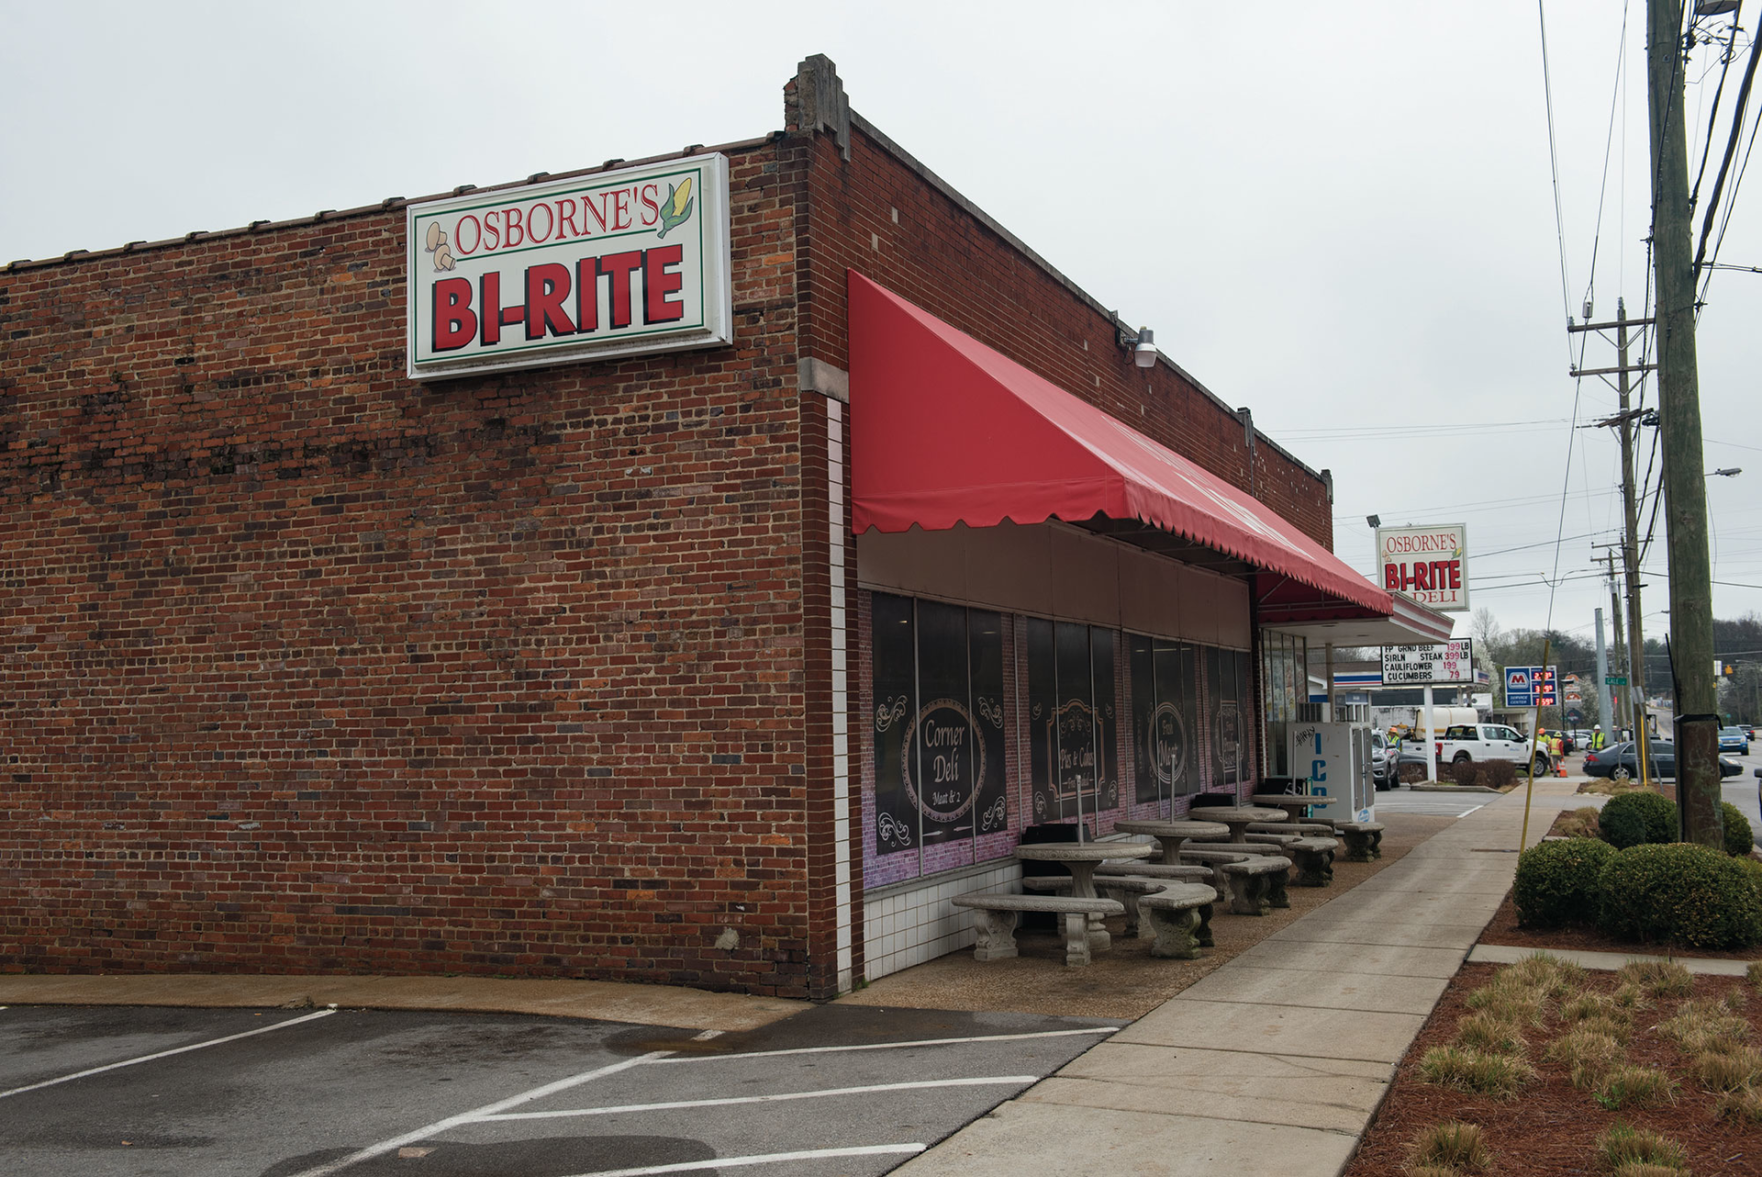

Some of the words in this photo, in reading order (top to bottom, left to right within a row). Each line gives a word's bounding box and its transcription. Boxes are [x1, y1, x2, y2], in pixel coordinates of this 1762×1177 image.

[454, 184, 659, 255] OSBORNE'S
[432, 244, 684, 353] BI-RITE
[1386, 533, 1456, 553] OSBORNE'S
[1385, 560, 1461, 591] BI-RITE
[1411, 591, 1457, 604] DELI
[1461, 642, 1469, 650] LB
[1384, 654, 1406, 662] SIRLN
[1420, 653, 1443, 661] STEAK
[1444, 652, 1460, 660] 399
[1460, 652, 1469, 660] LB
[1384, 662, 1433, 671] CAULIFLOWER
[1443, 661, 1457, 670] 199
[1387, 671, 1433, 681] CUCUMBERS
[1449, 670, 1460, 679] 79
[925, 719, 965, 748] Corner
[933, 747, 959, 783] Deli
